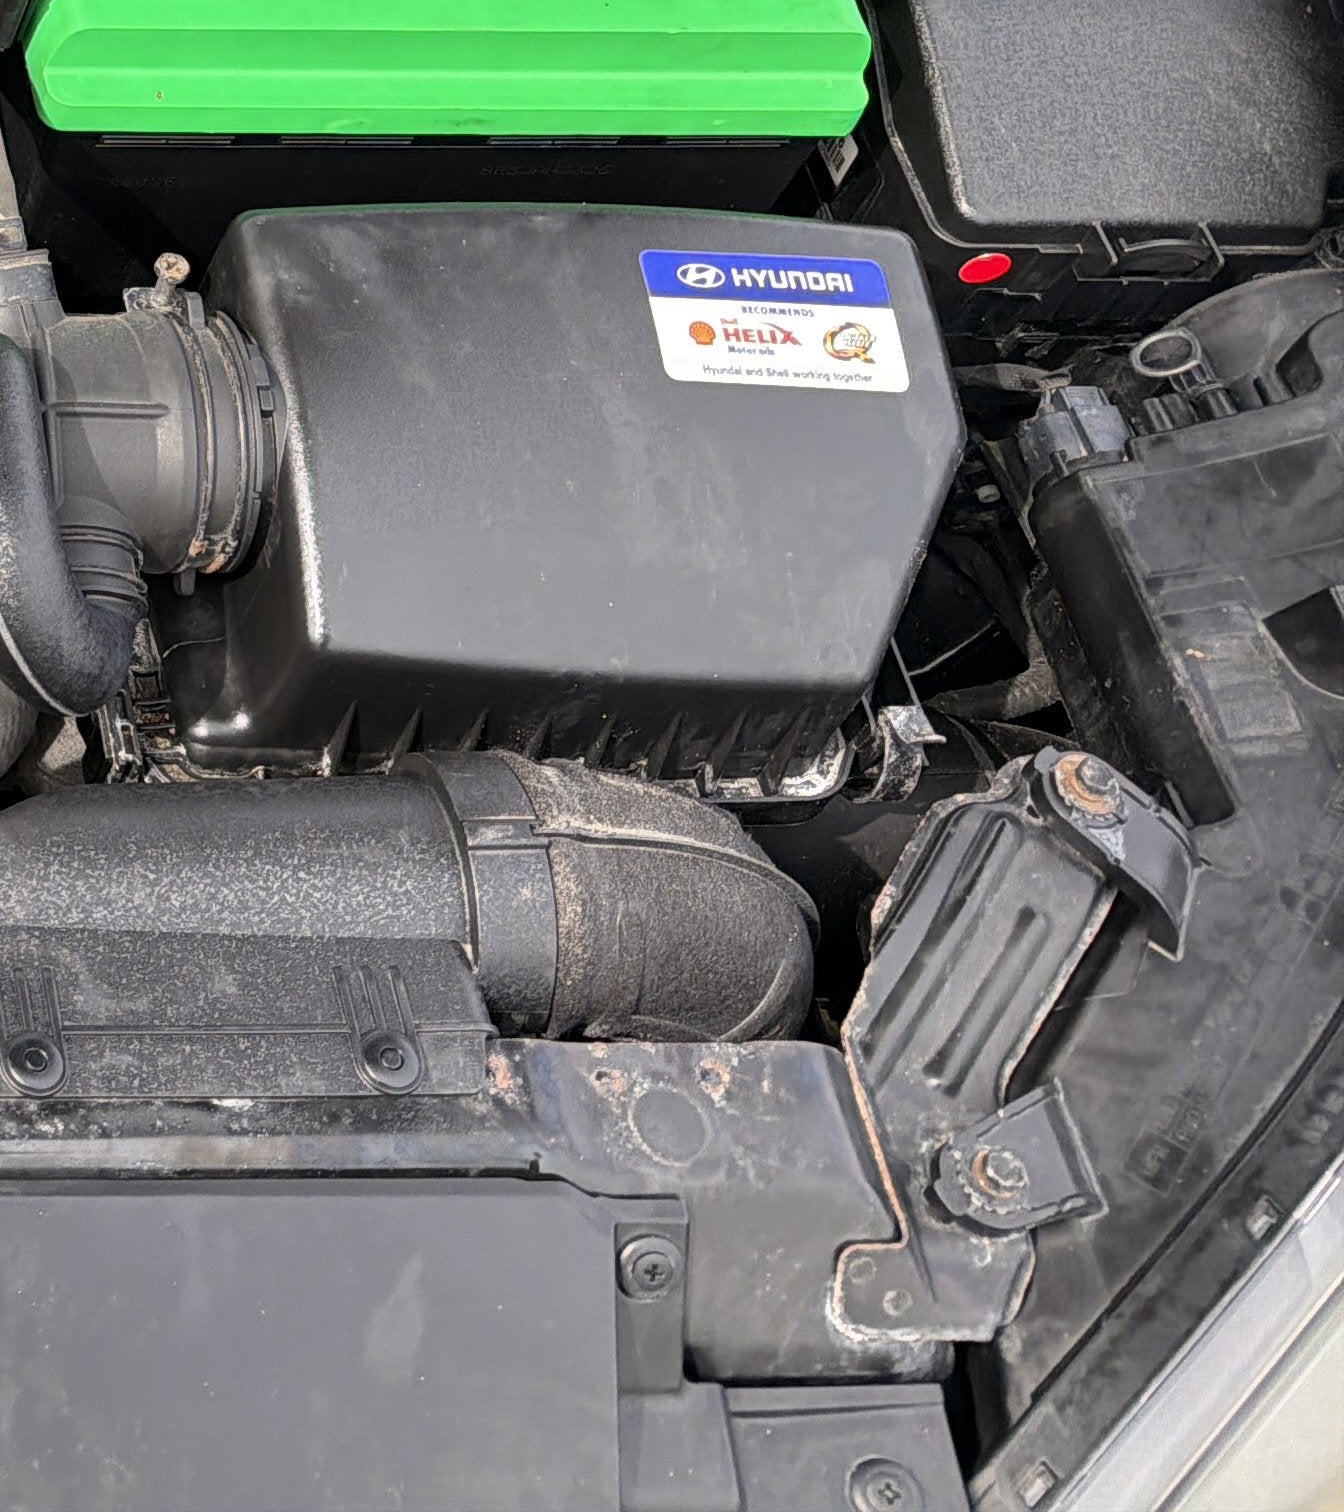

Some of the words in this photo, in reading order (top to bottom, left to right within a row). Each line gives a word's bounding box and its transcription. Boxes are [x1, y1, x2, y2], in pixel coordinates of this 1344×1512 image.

[730, 267, 854, 293] HYUNDAI
[740, 305, 815, 318] RECOMMENDS
[722, 325, 802, 346] HELIX
[727, 345, 753, 355] Motor
[702, 364, 742, 377] Hyundai
[745, 367, 763, 376] and
[766, 366, 789, 378] Shell
[792, 369, 831, 382] working
[833, 371, 873, 383] together
